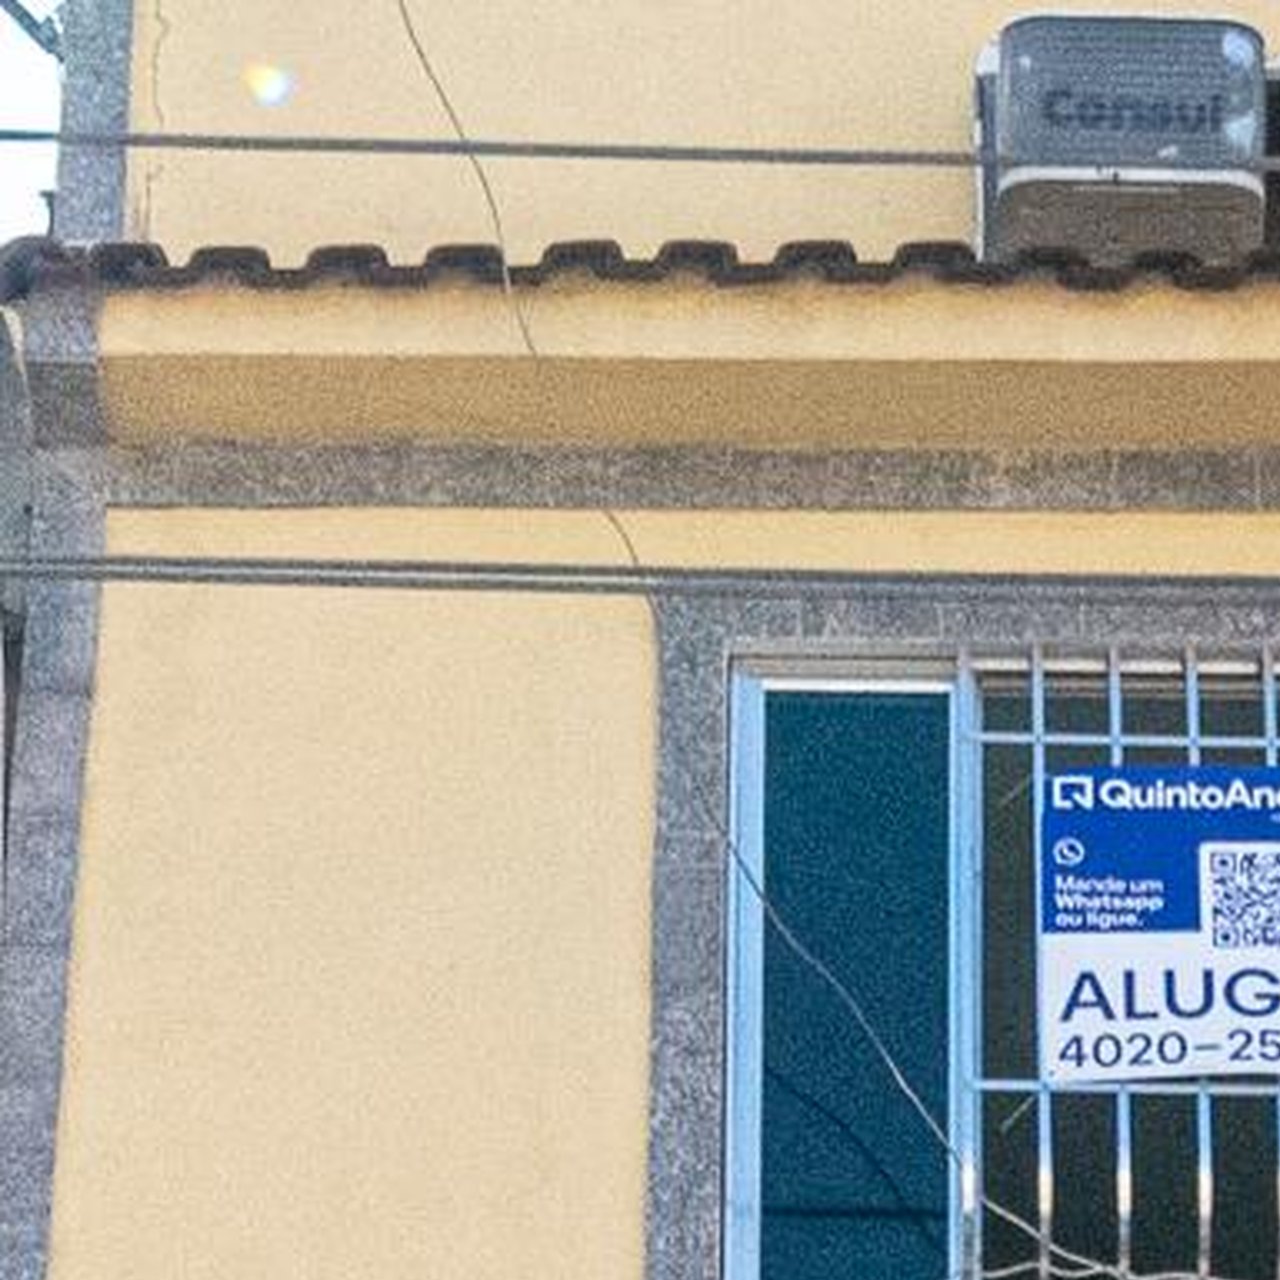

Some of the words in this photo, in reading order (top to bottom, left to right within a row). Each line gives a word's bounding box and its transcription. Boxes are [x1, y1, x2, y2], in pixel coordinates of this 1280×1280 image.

[1042, 88, 1225, 136] Consul
[1055, 875, 1127, 893] Mande
[1129, 879, 1164, 893] um
[1055, 912, 1083, 927] ou
[1086, 910, 1144, 930] ligue.
